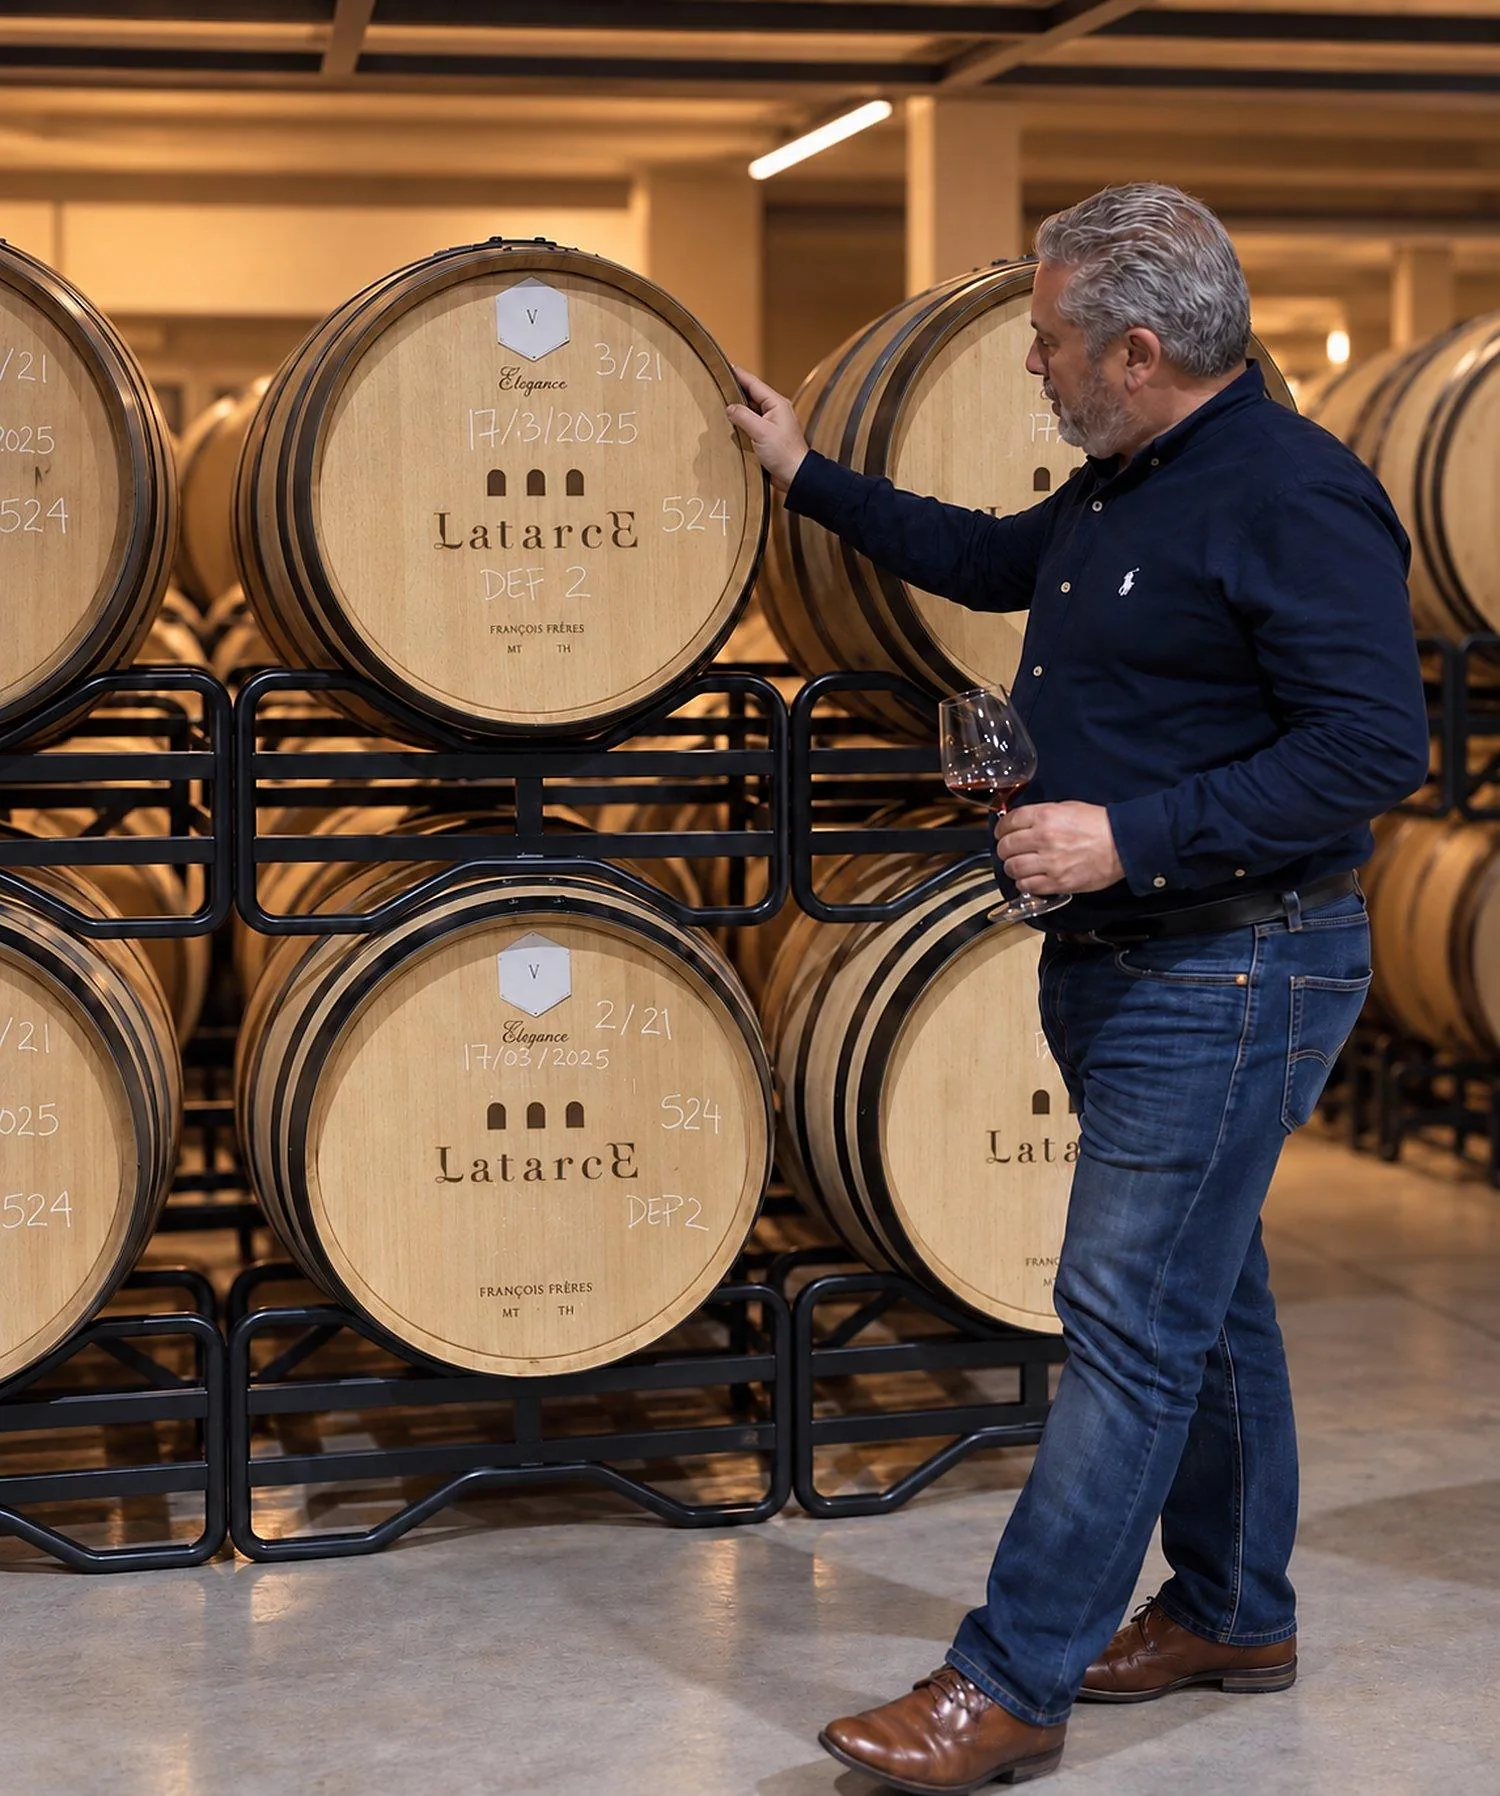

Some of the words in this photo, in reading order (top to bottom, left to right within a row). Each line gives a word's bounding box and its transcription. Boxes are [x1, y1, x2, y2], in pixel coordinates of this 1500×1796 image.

[526, 308, 538, 325] V
[594, 343, 663, 381] 3/21
[499, 365, 568, 397] Elegance
[0, 425, 55, 455] 025
[467, 407, 639, 451] 17/3/2025
[0, 496, 69, 534] 524
[433, 511, 638, 551] LatarcE
[661, 495, 731, 536] 524
[480, 567, 545, 601] DEF
[564, 566, 592, 599] 2
[490, 624, 544, 638] FRANÇOIS
[507, 644, 523, 654] MT
[556, 643, 573, 654] TH
[528, 964, 540, 981] V
[502, 1020, 570, 1049] Elegance
[594, 1000, 673, 1040] 2/21
[462, 1043, 610, 1071] 17/03/2025
[660, 1093, 722, 1135] 524
[434, 1142, 639, 1184] LatarcE
[2, 1190, 73, 1229] 524
[479, 1284, 545, 1300] FRANÇOIS
[502, 1308, 521, 1318] MT
[557, 1305, 575, 1316] TH
